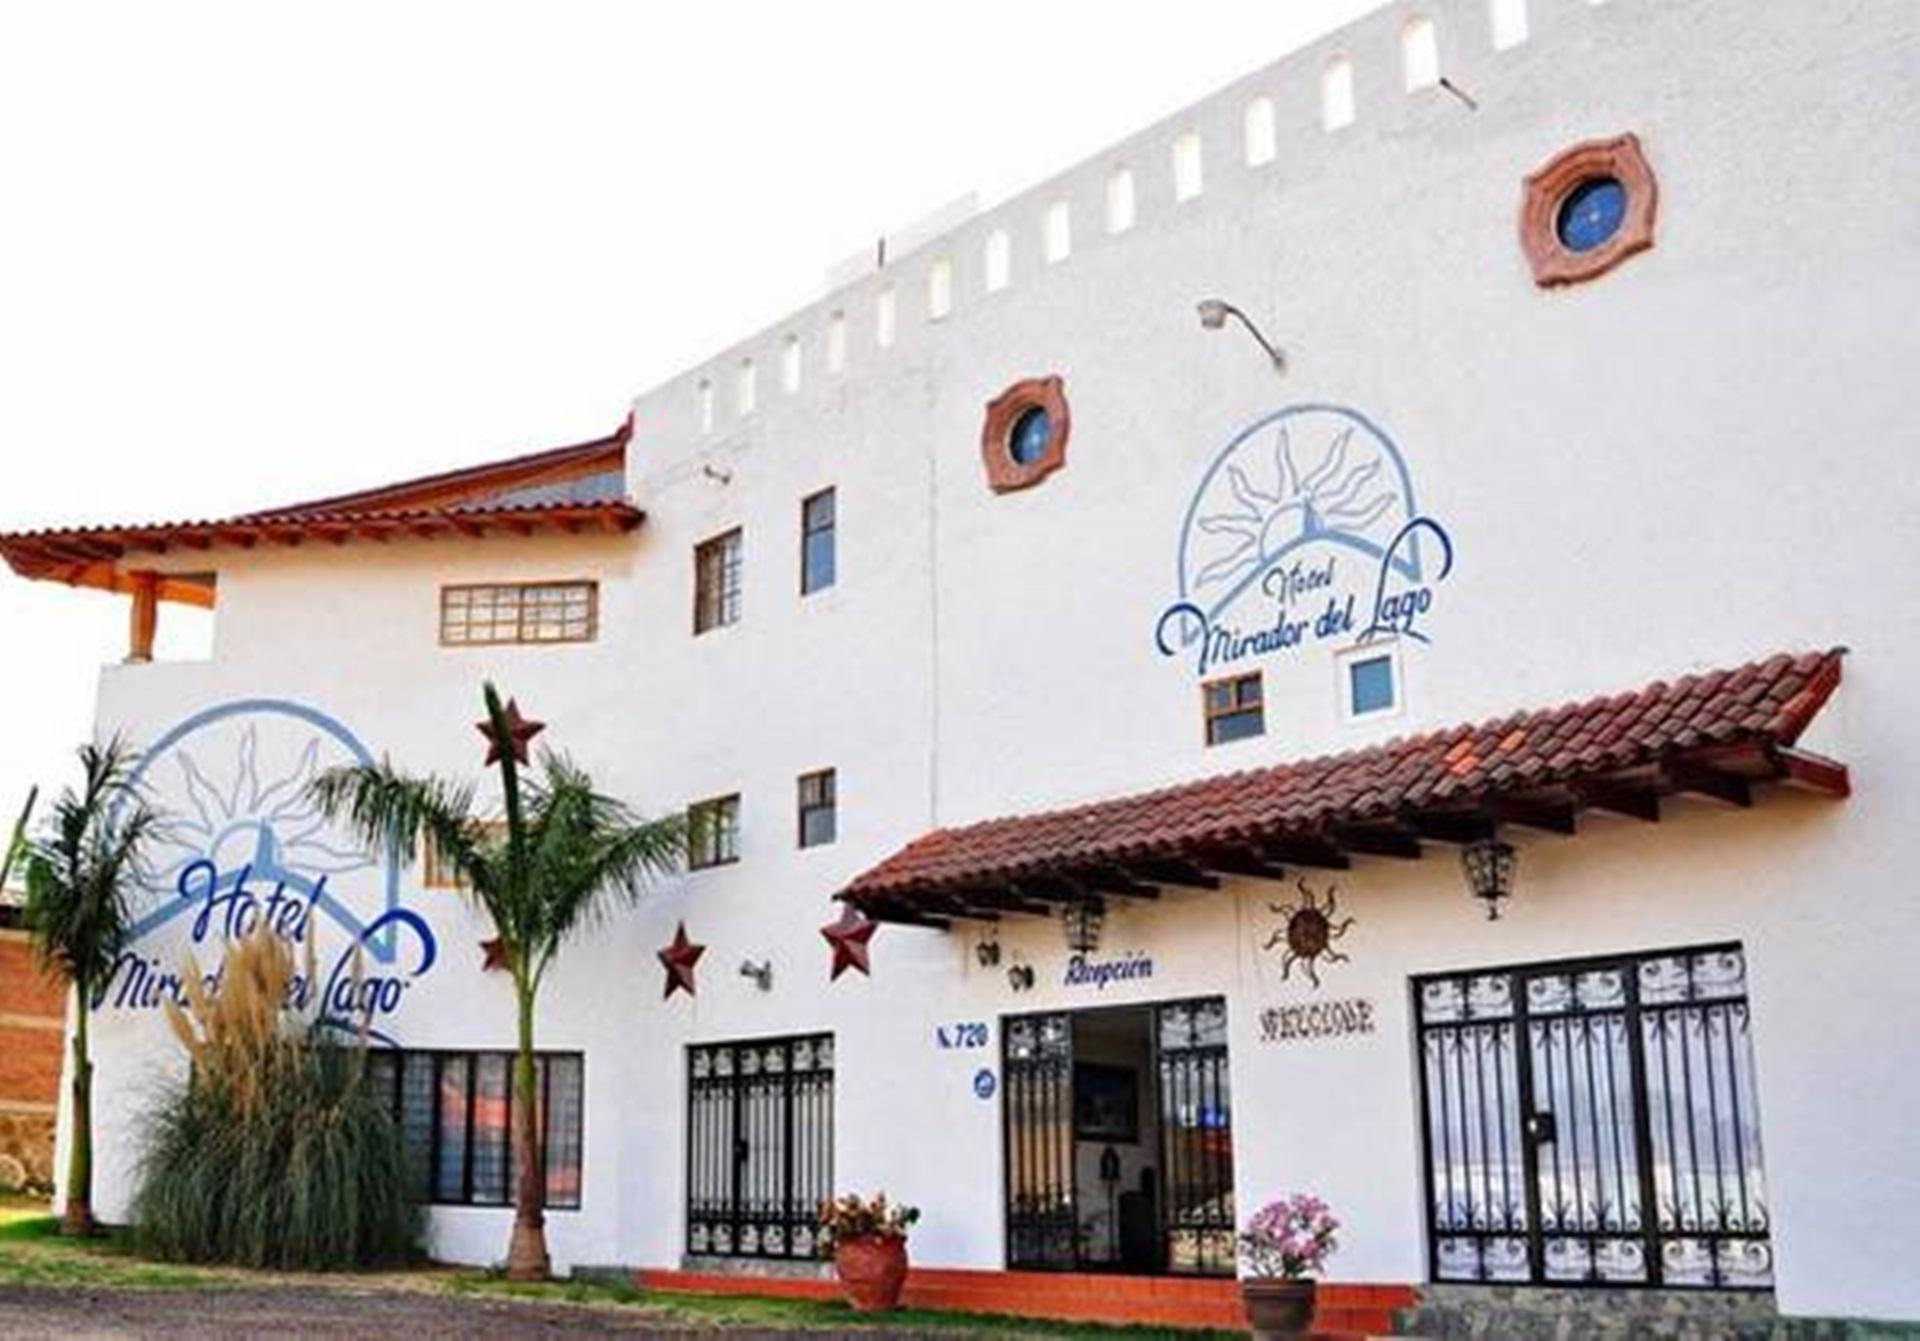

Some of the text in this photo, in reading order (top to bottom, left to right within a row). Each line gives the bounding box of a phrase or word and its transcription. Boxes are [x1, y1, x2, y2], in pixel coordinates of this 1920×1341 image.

[1156, 518, 1454, 676] Mirador del Lago
[1262, 557, 1335, 604] Hotel
[177, 859, 328, 943] Hotel
[308, 908, 437, 1048] Lago
[1260, 1000, 1375, 1041] WELCOME
